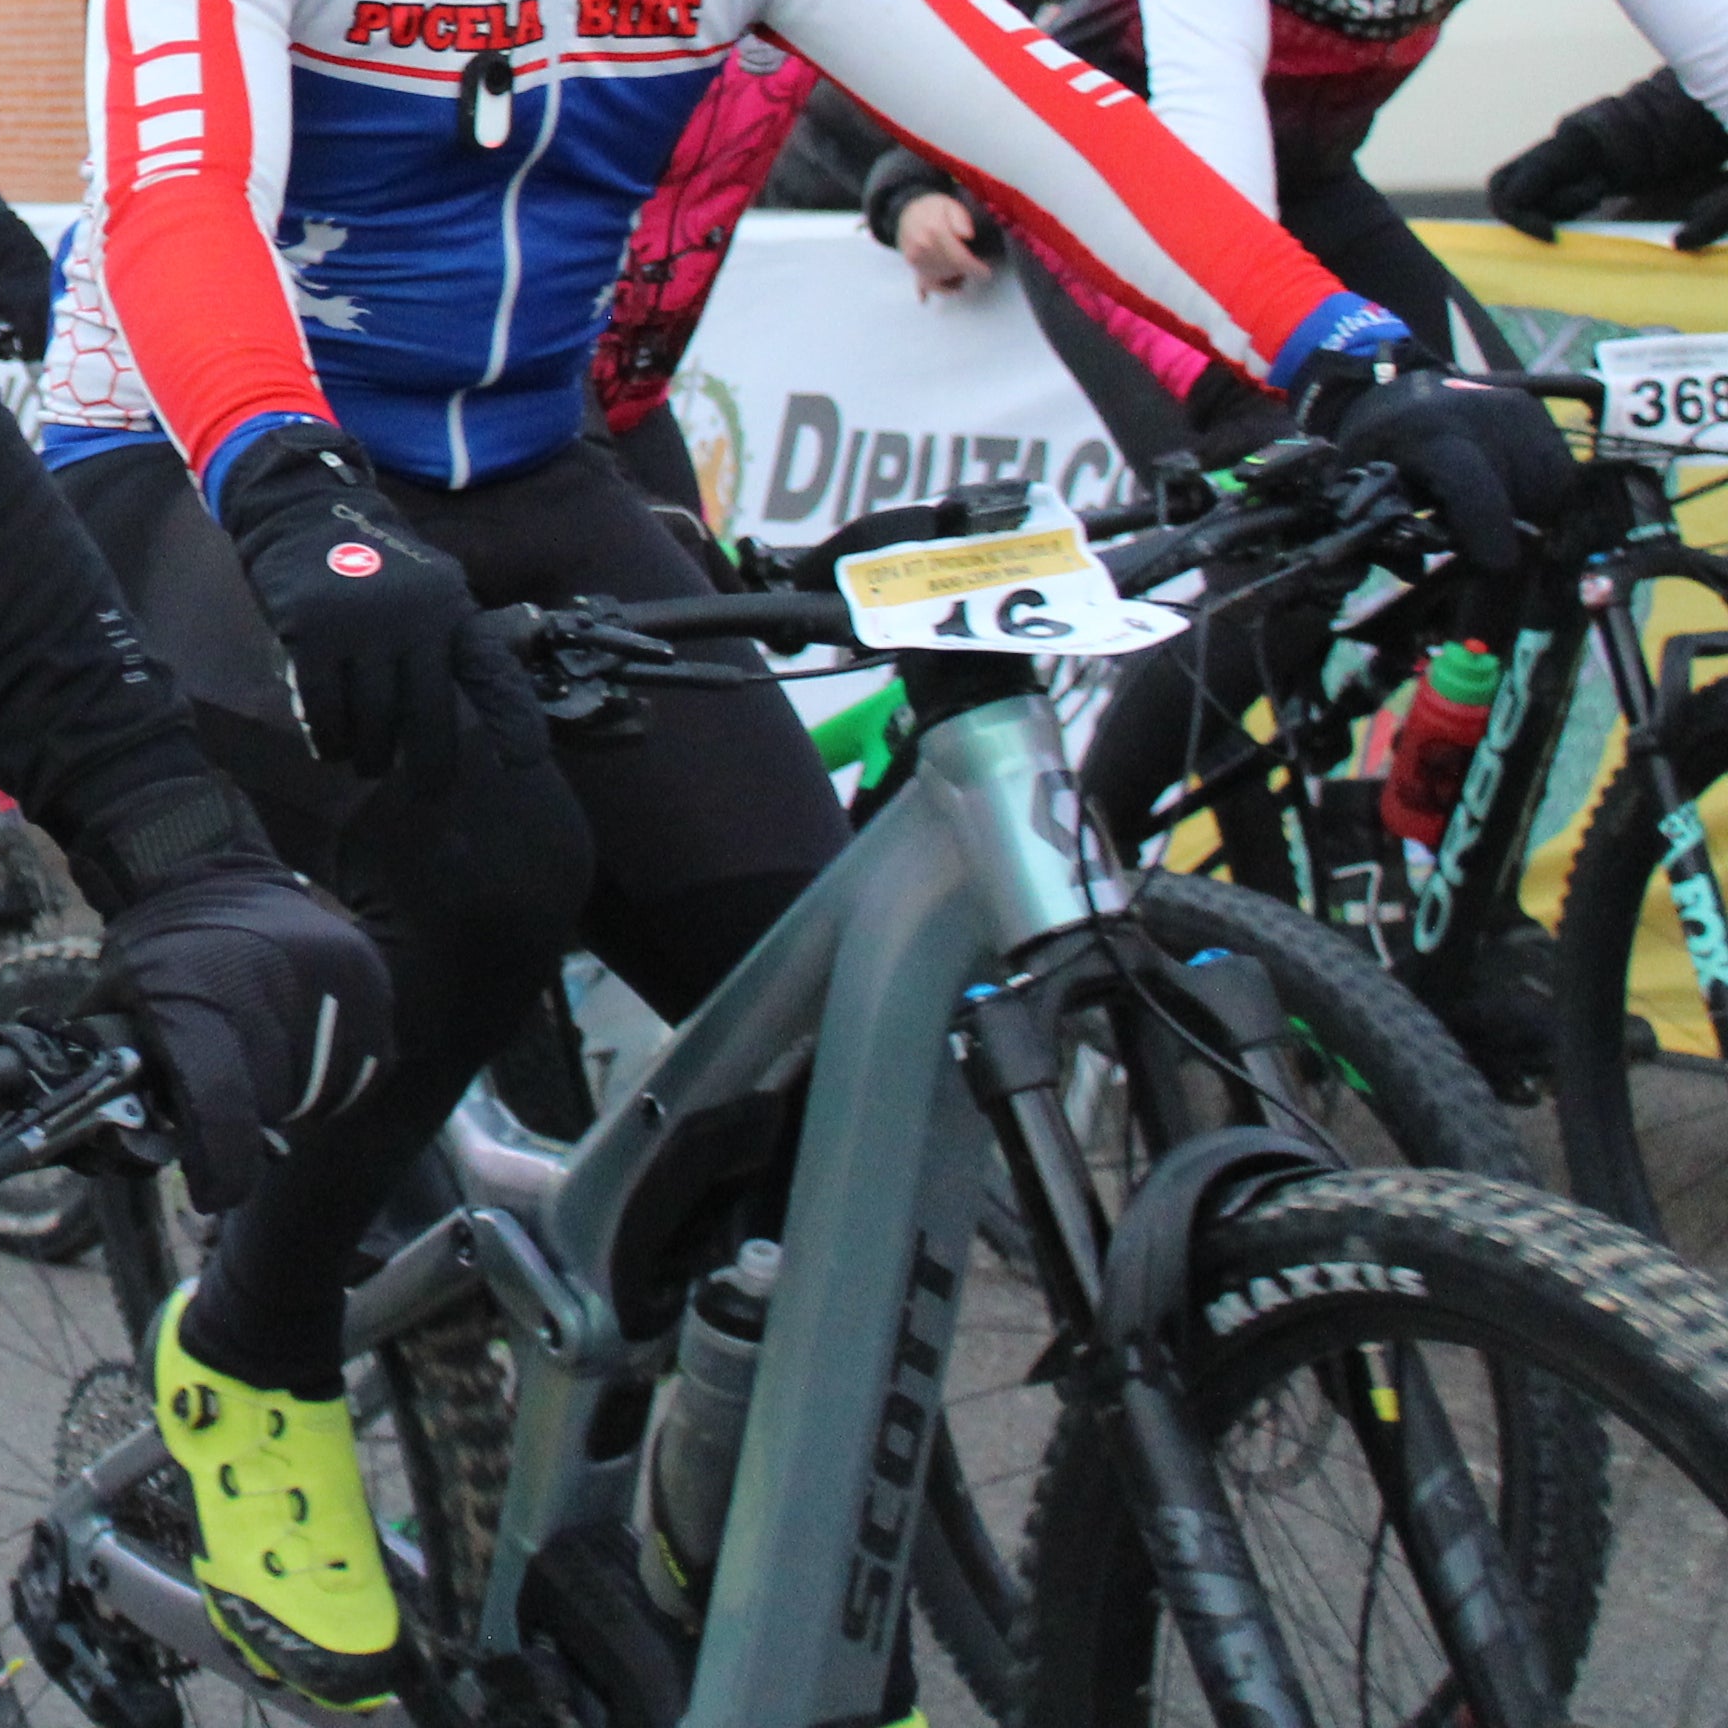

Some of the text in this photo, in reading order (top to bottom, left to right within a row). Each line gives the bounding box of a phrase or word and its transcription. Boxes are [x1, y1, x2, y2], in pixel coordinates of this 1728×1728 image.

[932, 587, 1076, 641] 16
[1204, 1260, 1428, 1336] MAXXIS
[841, 1228, 956, 1654] SCOTT
